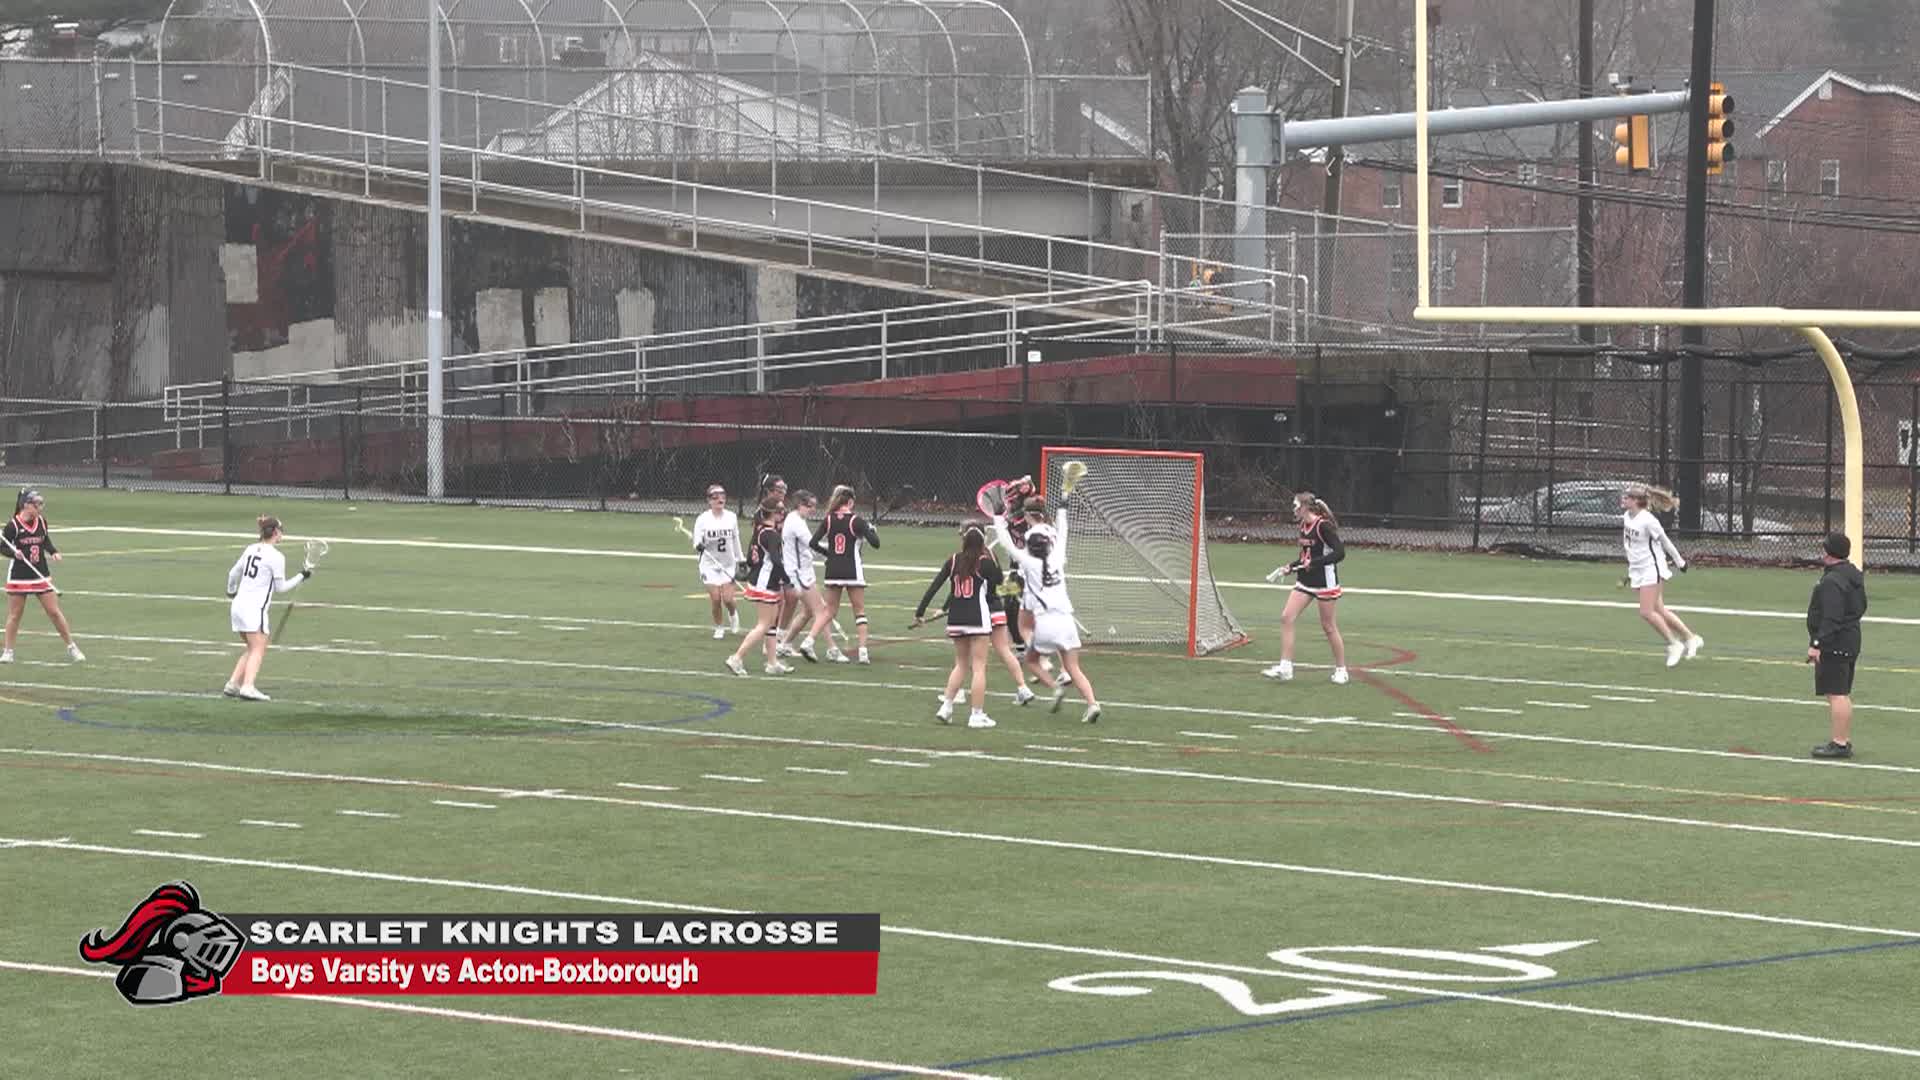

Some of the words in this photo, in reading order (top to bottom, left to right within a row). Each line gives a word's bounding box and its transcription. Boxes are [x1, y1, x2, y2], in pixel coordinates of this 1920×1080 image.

[717, 538, 727, 552] 2
[834, 533, 846, 554] 8
[244, 555, 262, 579] 15
[954, 575, 973, 598] 10
[1047, 946, 1558, 1016] 20
